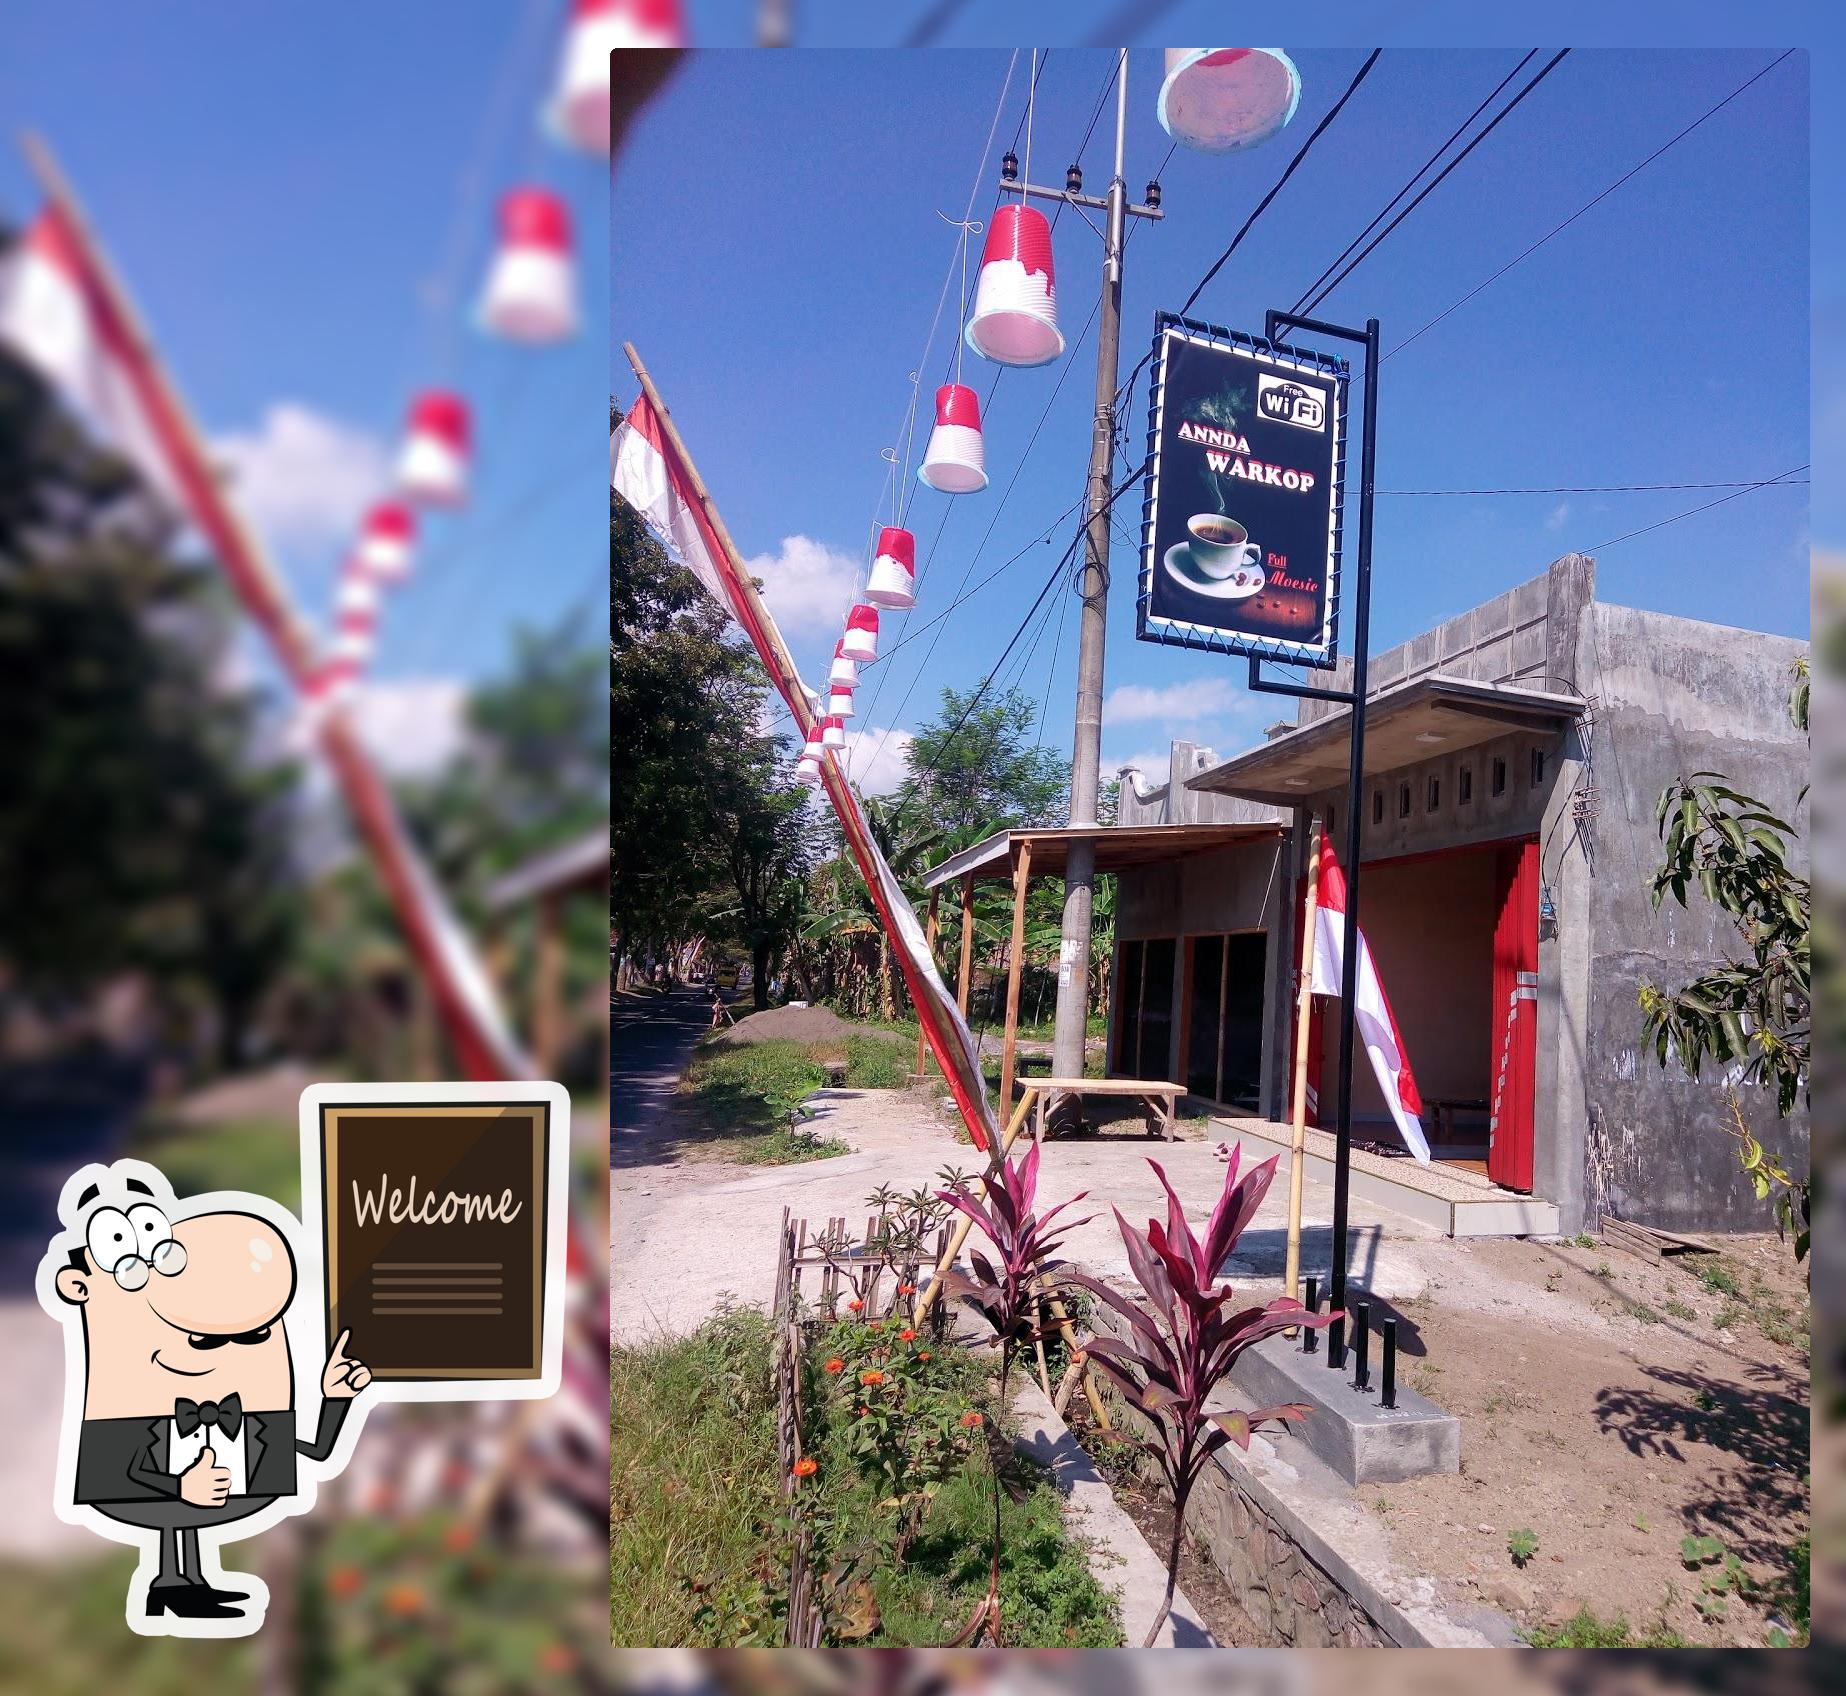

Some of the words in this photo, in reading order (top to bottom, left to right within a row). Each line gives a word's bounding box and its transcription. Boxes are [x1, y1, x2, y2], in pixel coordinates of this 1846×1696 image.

[1283, 384, 1304, 397] Free
[1178, 421, 1251, 453] ANNDA
[1205, 451, 1315, 492] WARKOP
[1268, 553, 1288, 567] Full
[1267, 571, 1318, 592] Moesic
